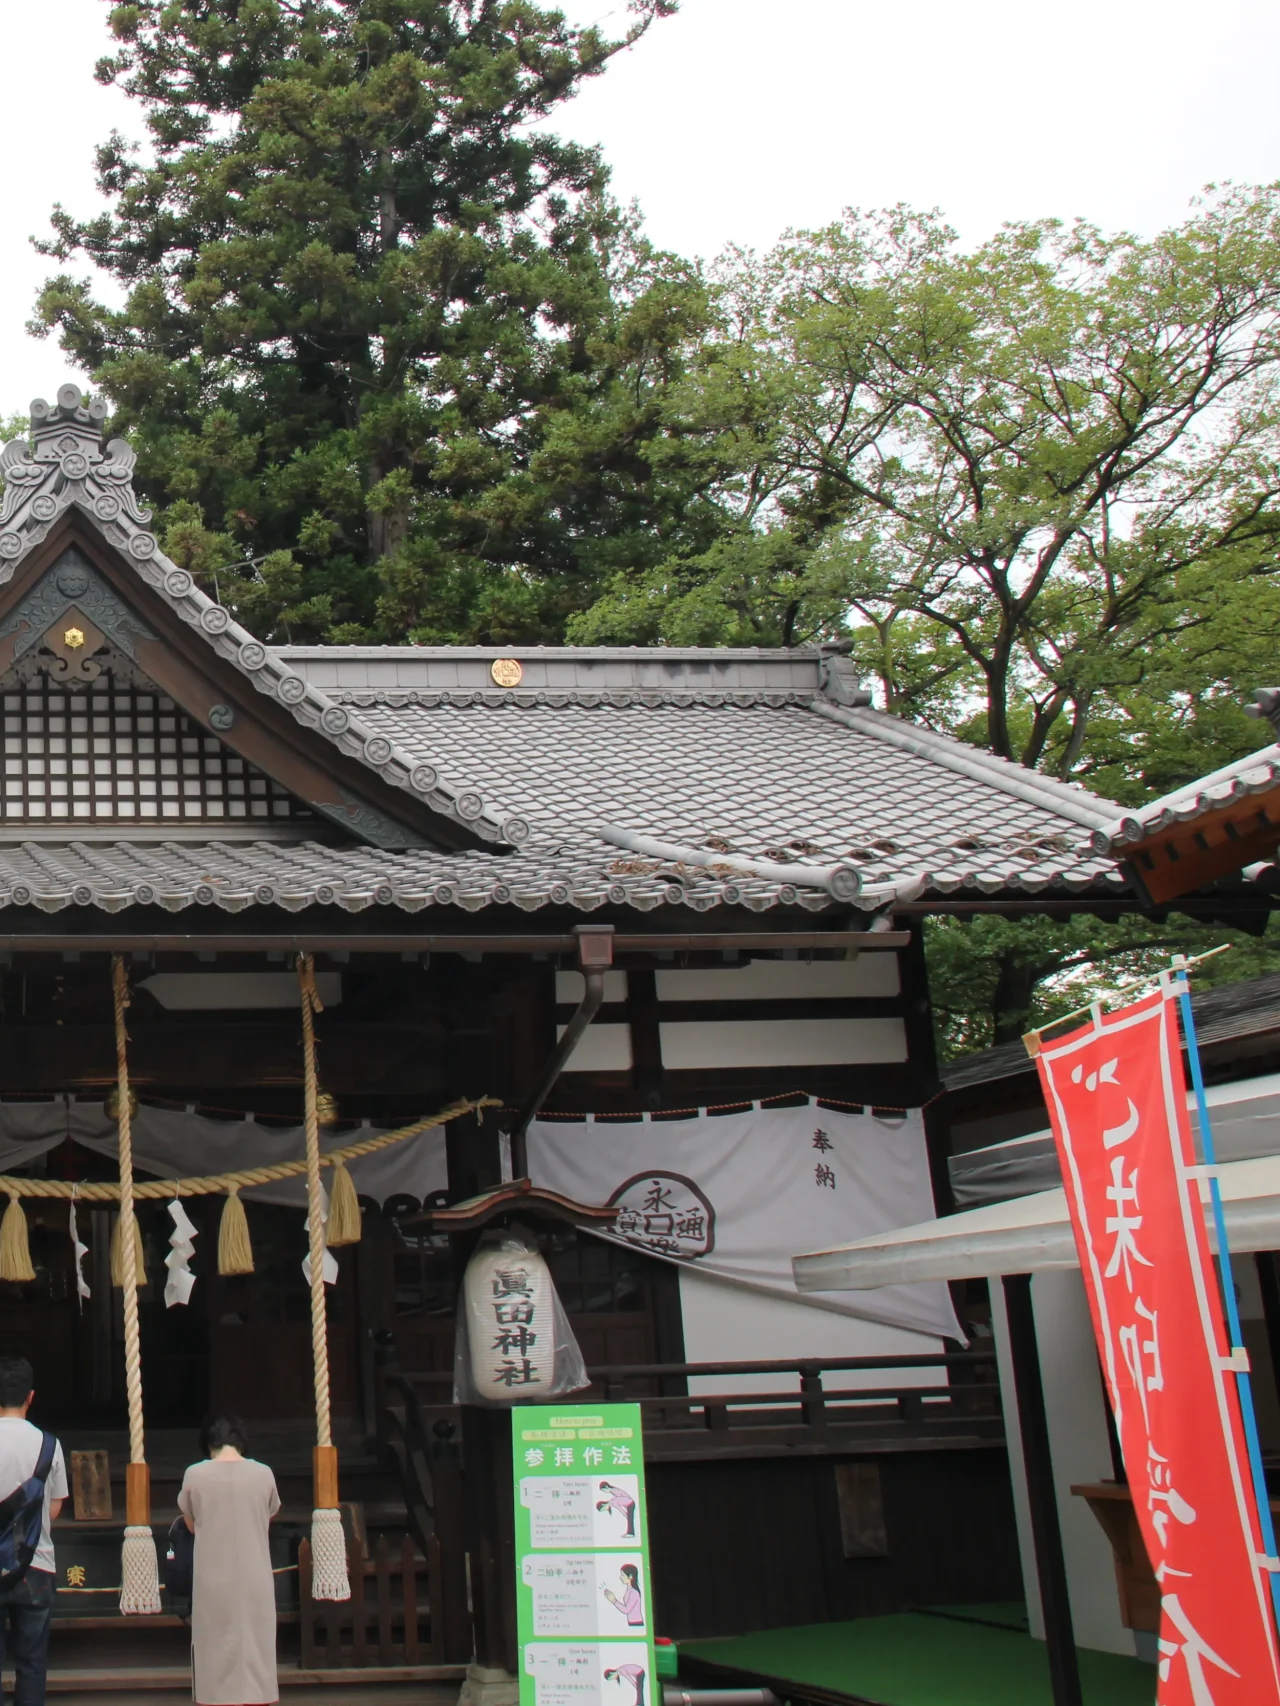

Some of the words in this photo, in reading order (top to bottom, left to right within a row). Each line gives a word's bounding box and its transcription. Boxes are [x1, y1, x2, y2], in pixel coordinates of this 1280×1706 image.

[812, 1128, 836, 1190] 奉納
[524, 1445, 632, 1467] 参拝作法
[523, 1487, 528, 1497] 1
[525, 1564, 532, 1575] 2
[528, 1653, 535, 1665] 3
